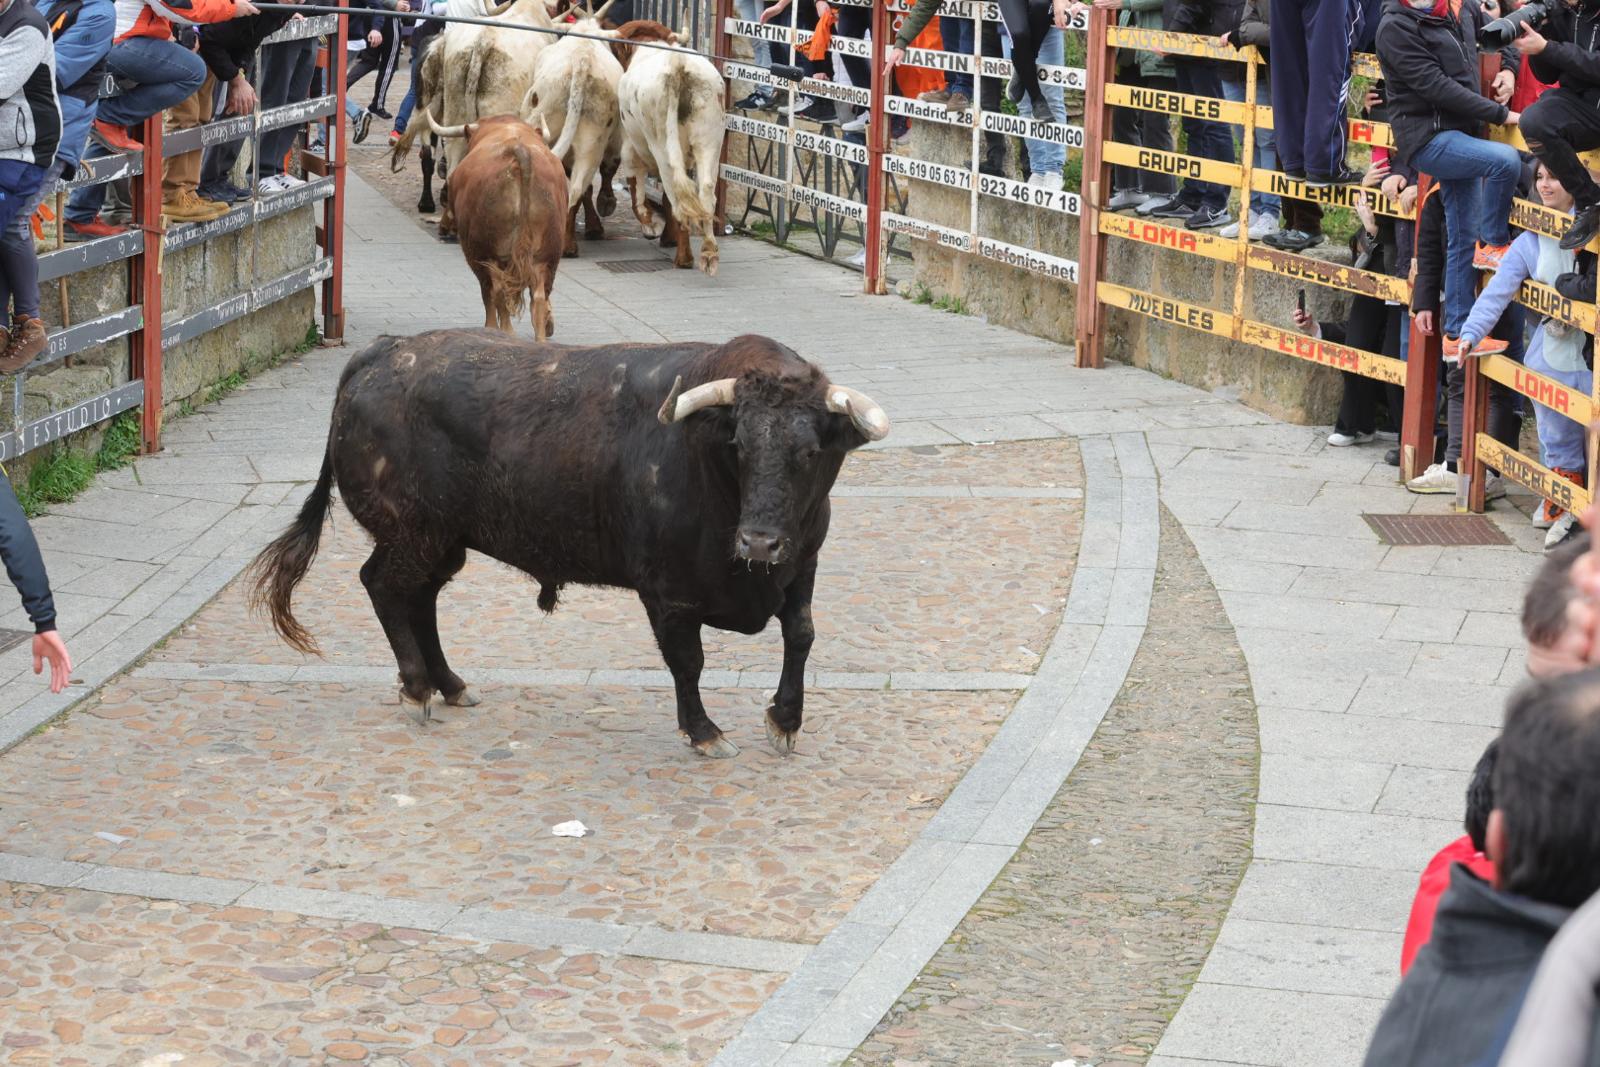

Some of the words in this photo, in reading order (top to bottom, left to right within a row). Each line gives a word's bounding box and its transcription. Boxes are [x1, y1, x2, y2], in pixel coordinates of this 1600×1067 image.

[898, 0, 973, 17] GRALI
[736, 21, 787, 42] MARTIN
[848, 42, 870, 56] S.C.
[726, 65, 736, 77] C/
[777, 76, 789, 88] 28
[830, 85, 869, 105] RODRIGO
[901, 49, 968, 71] MARTIN
[1053, 70, 1082, 86] S.C.
[888, 100, 900, 113] C/
[904, 102, 951, 122] Madrid,
[956, 111, 973, 125] 28
[985, 115, 1026, 135] CIUDAD
[1030, 121, 1082, 146] RODRIGO
[1130, 88, 1220, 119] MUEBLES
[742, 120, 755, 134] 619
[756, 124, 766, 137] 05
[767, 126, 777, 139] 63
[779, 129, 788, 142] 71
[795, 134, 815, 149] 923
[818, 138, 831, 153] 46
[834, 142, 848, 158] 07
[852, 147, 866, 163] 18
[1139, 150, 1201, 178] GRUPO
[885, 157, 907, 174] Tels.
[909, 161, 926, 178] 619
[929, 167, 941, 182] 05
[944, 169, 956, 184] 63
[959, 172, 970, 189] 71
[981, 177, 1007, 197] 923
[1012, 183, 1029, 202] 46
[1035, 189, 1053, 207] 07
[1059, 194, 1077, 213] 18
[1128, 220, 1197, 252] LOMA
[1128, 293, 1214, 330] MUEBLES
[1520, 281, 1572, 320] GRUPO
[1279, 331, 1360, 371] LOMA
[1514, 368, 1569, 414] LOMA
[34, 397, 111, 446] ESTUDIO
